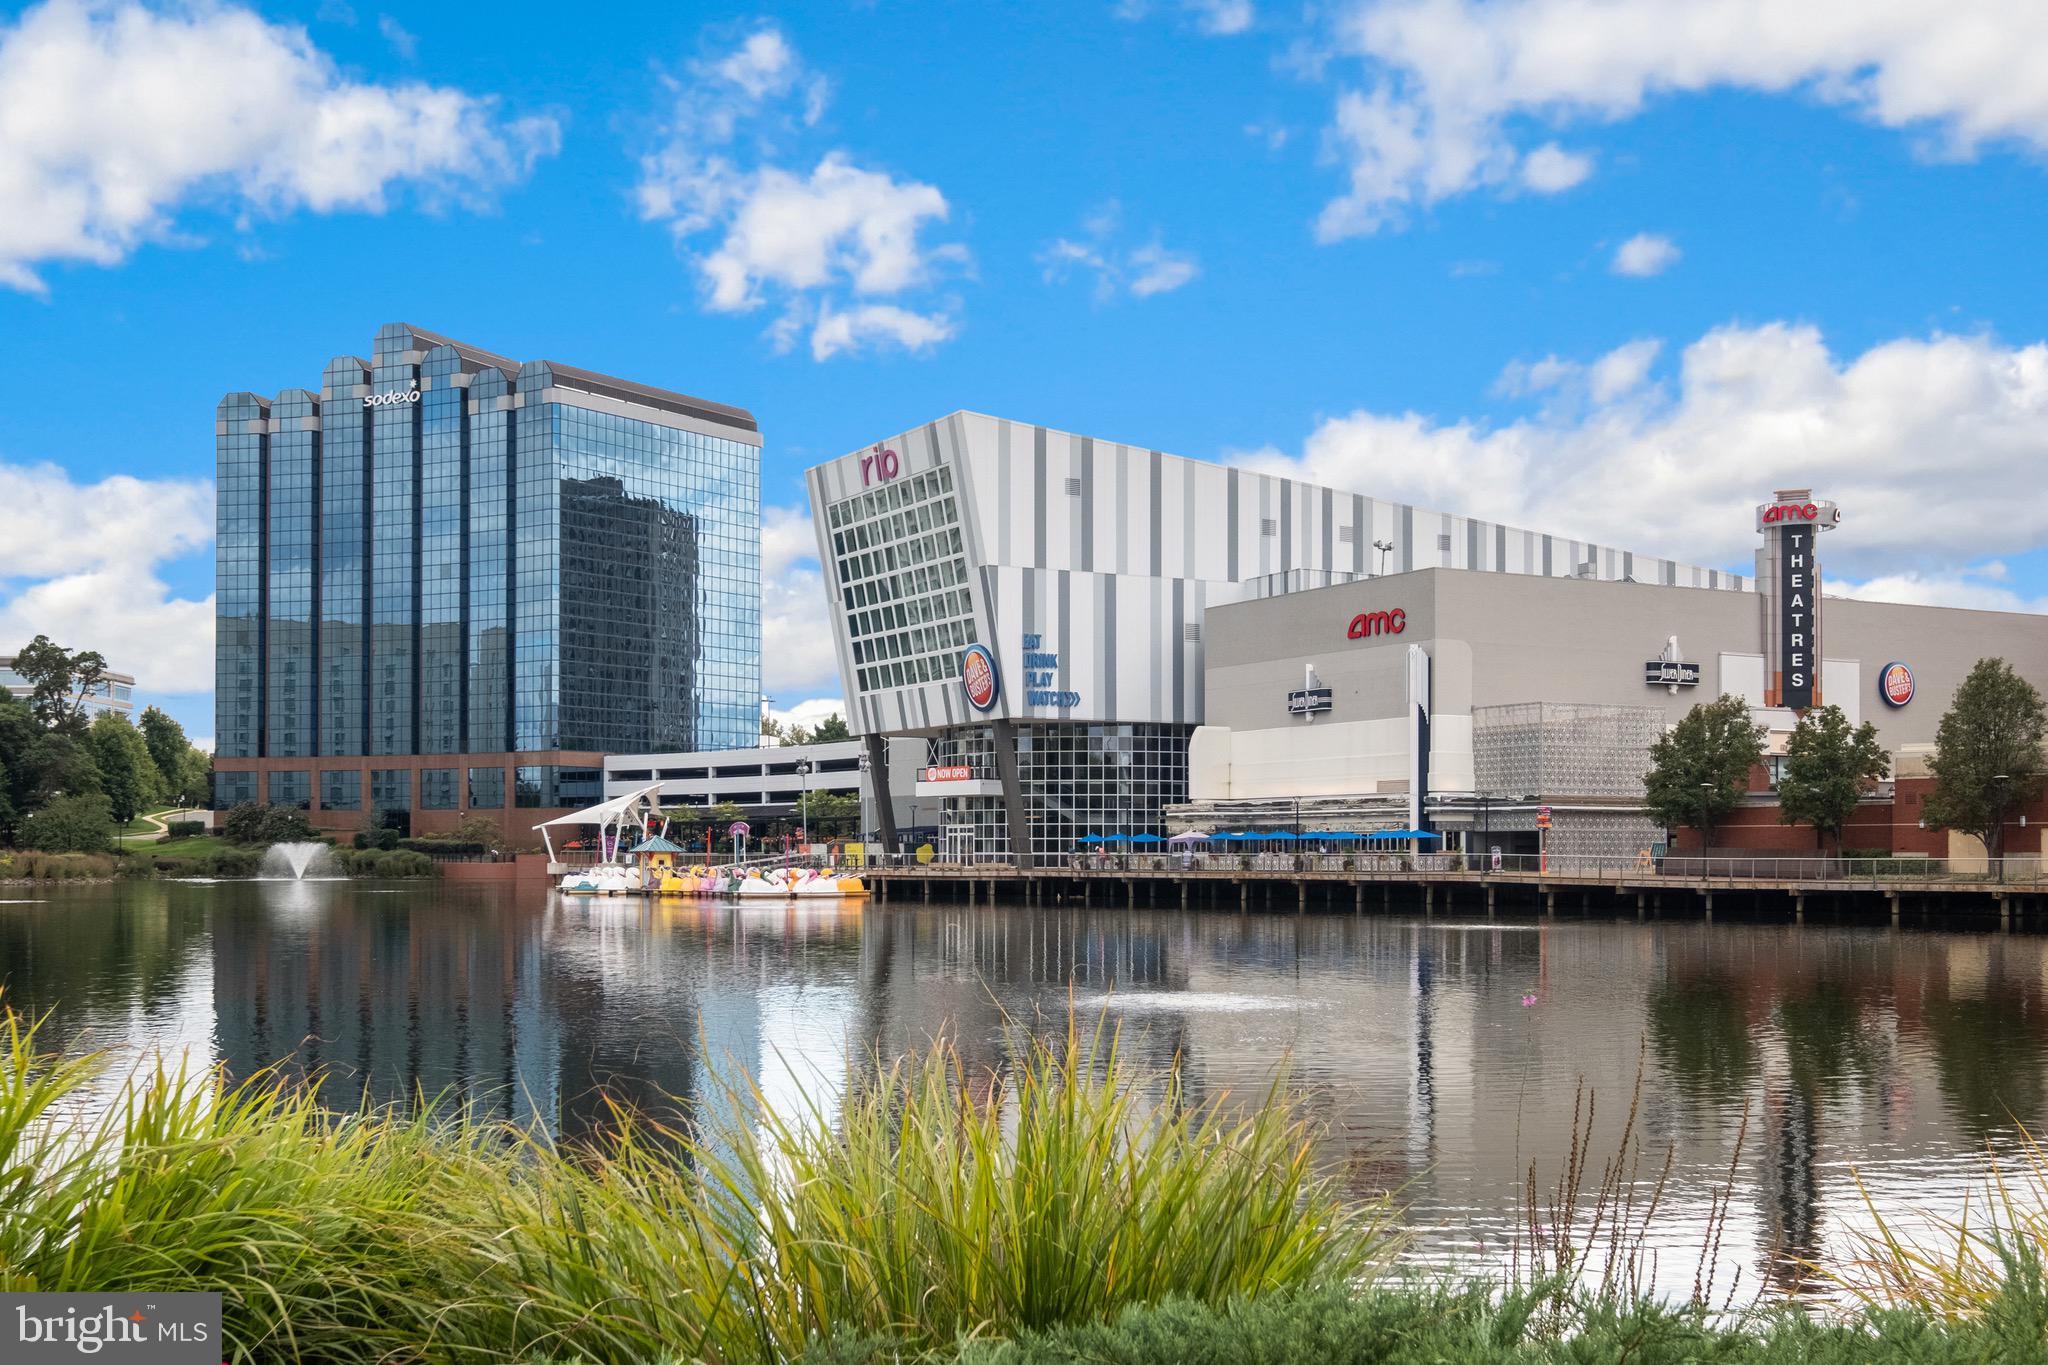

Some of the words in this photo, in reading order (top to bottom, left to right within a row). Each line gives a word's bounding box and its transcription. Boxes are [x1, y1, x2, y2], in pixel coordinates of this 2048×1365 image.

[363, 389, 420, 407] sodexo
[861, 446, 899, 486] rio
[1791, 534, 1804, 687] THEATRES
[1023, 634, 1041, 649] EAT
[1023, 653, 1058, 668] DRINK
[966, 661, 983, 684] DAVE
[1025, 671, 1053, 687] PLAY
[1888, 672, 1905, 687] DAVE
[1027, 690, 1066, 707] WATCH
[937, 769, 951, 779] NOW
[951, 768, 968, 778] OPEN
